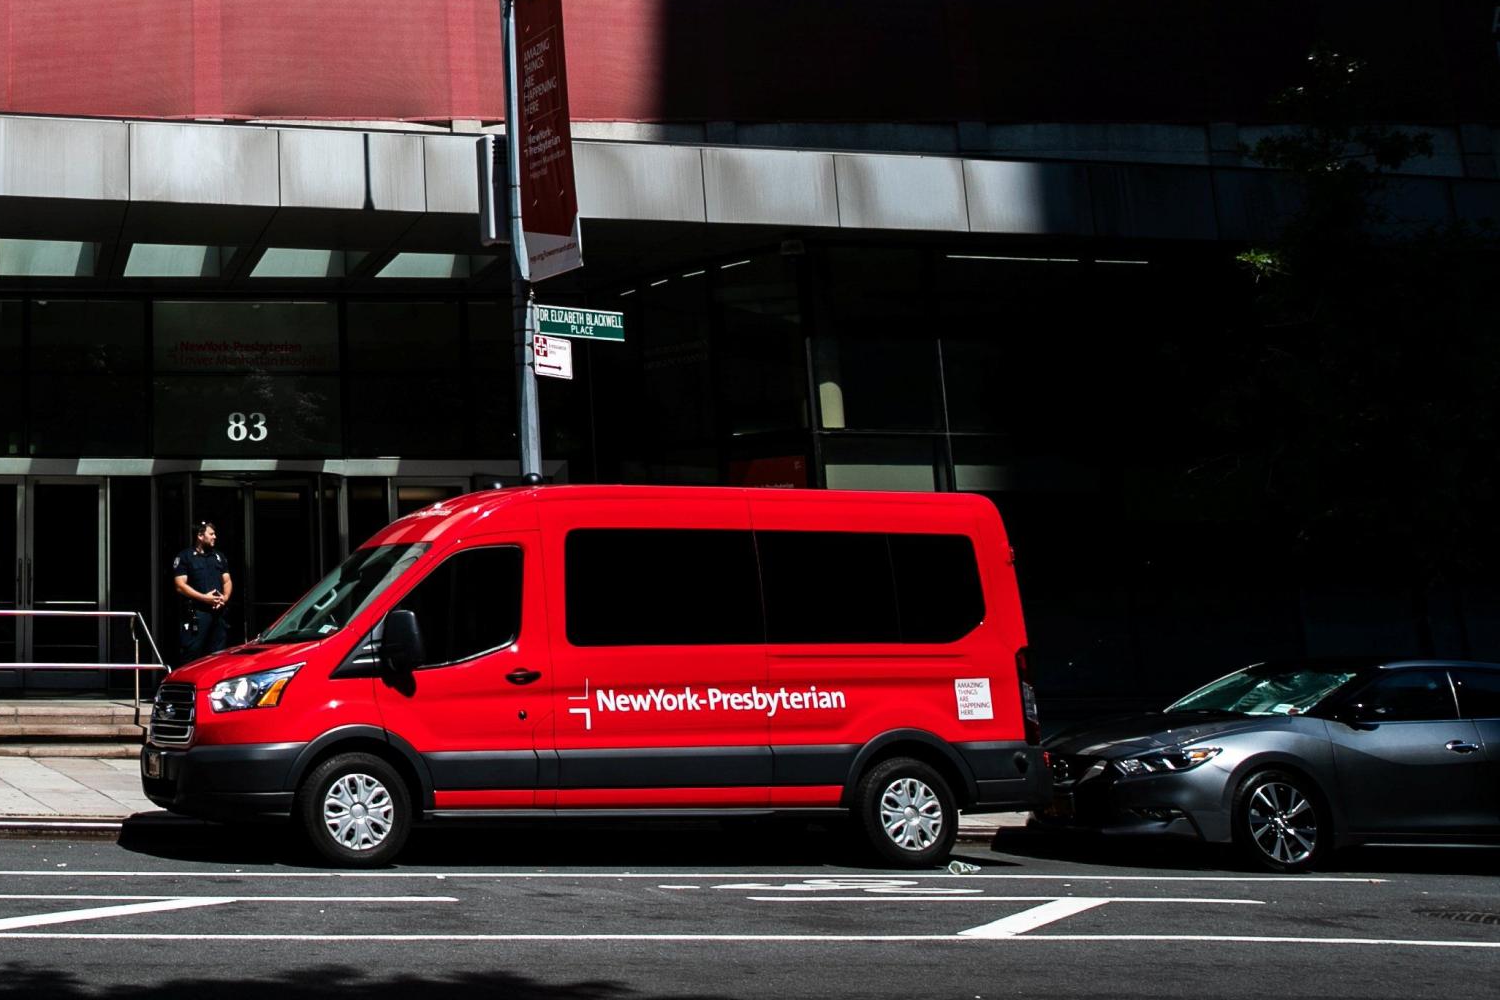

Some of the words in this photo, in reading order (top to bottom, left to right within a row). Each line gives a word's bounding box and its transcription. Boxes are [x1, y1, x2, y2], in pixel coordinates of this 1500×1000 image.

[551, 310, 585, 324] ELIZABETH
[586, 313, 623, 329] BLACKWELL
[571, 325, 594, 335] PLACE
[226, 411, 268, 441] 83
[596, 686, 846, 717] NewYork-Presbyterian
